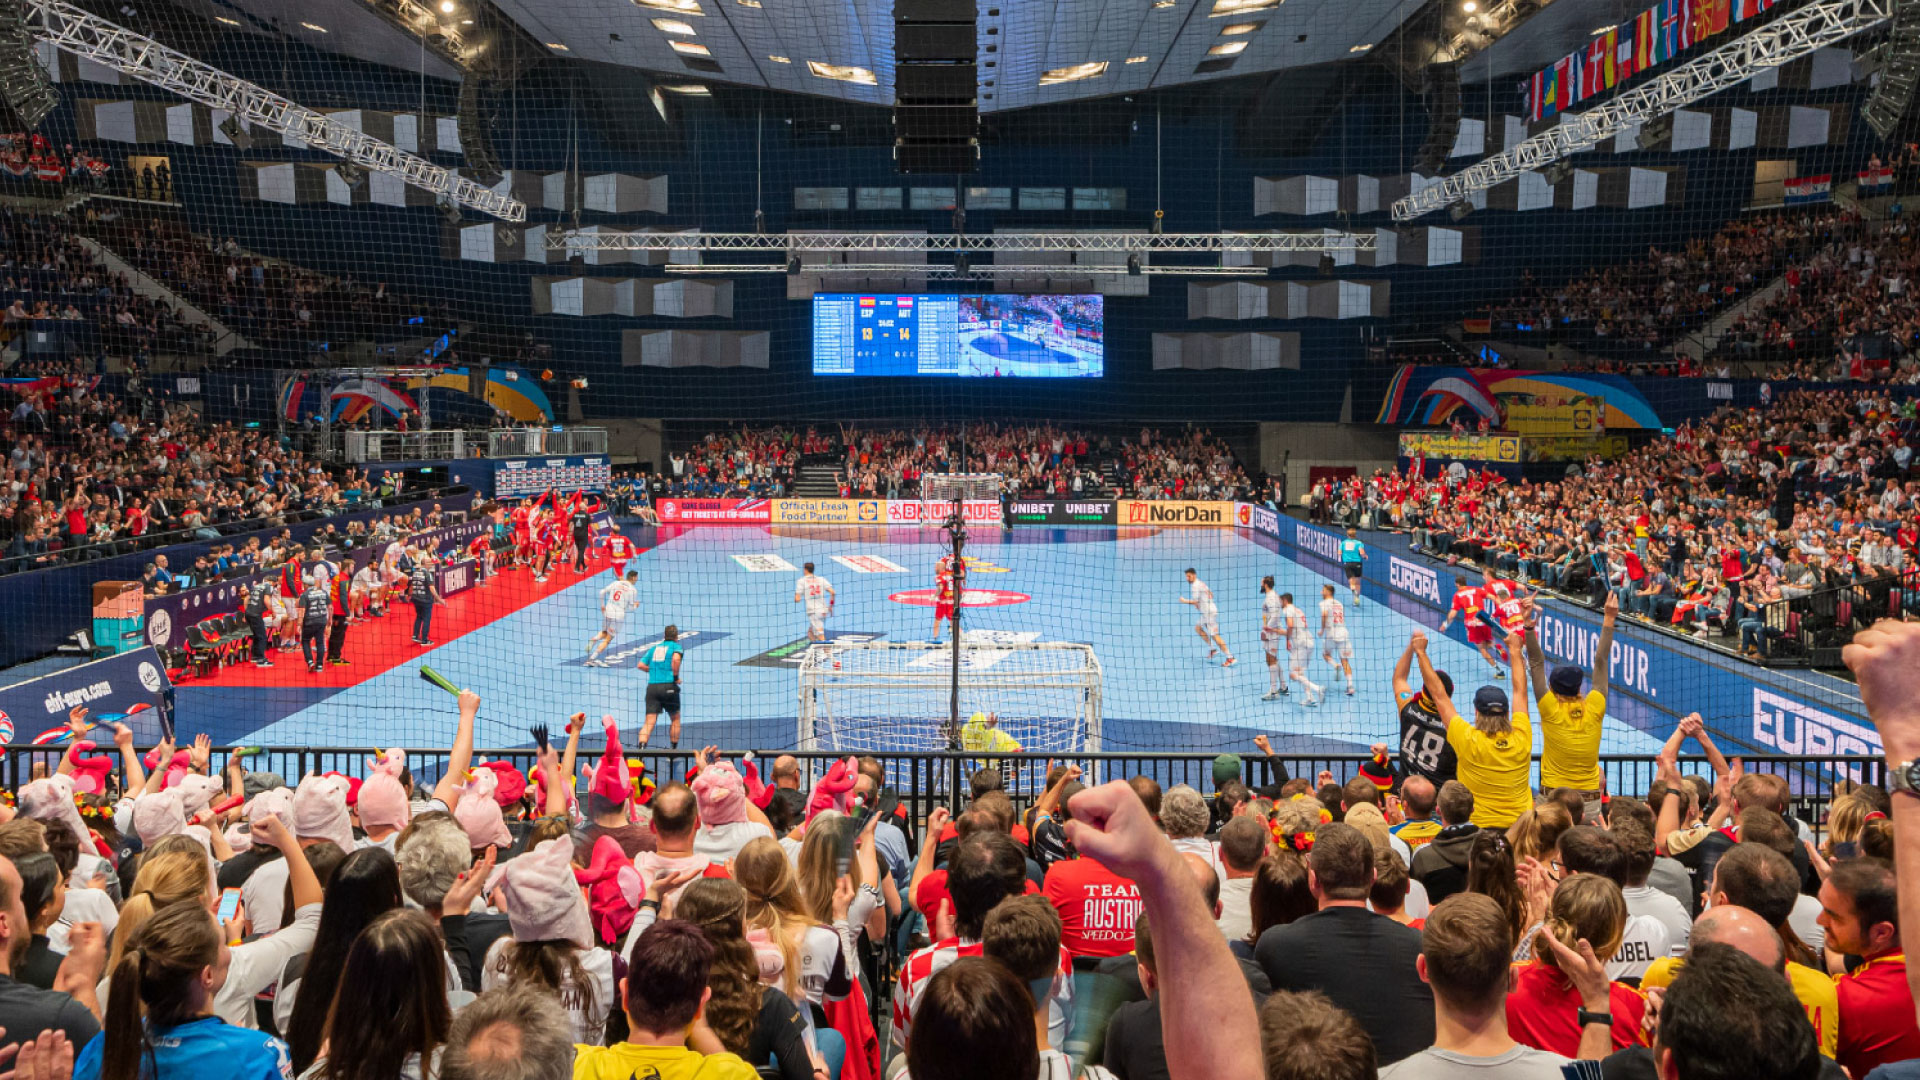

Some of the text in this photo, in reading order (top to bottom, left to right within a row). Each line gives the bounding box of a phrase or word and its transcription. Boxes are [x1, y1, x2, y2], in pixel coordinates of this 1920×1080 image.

[861, 309, 874, 318] ESP
[898, 309, 911, 318] AUT
[862, 328, 873, 340] 13
[899, 328, 910, 340] 14
[780, 501, 848, 510] Official Fresh
[1010, 503, 1054, 514] UNIBET
[1065, 503, 1110, 514] UNIBET
[781, 511, 847, 520] Food Partner
[1150, 506, 1222, 522] NorDan
[1256, 507, 1279, 537] EUROPA
[1390, 555, 1441, 604] EUROPA
[613, 590, 622, 601] 6
[1610, 640, 1657, 697] PUR.
[44, 681, 113, 714] ehf-euro.com
[1401, 724, 1445, 772] 48
